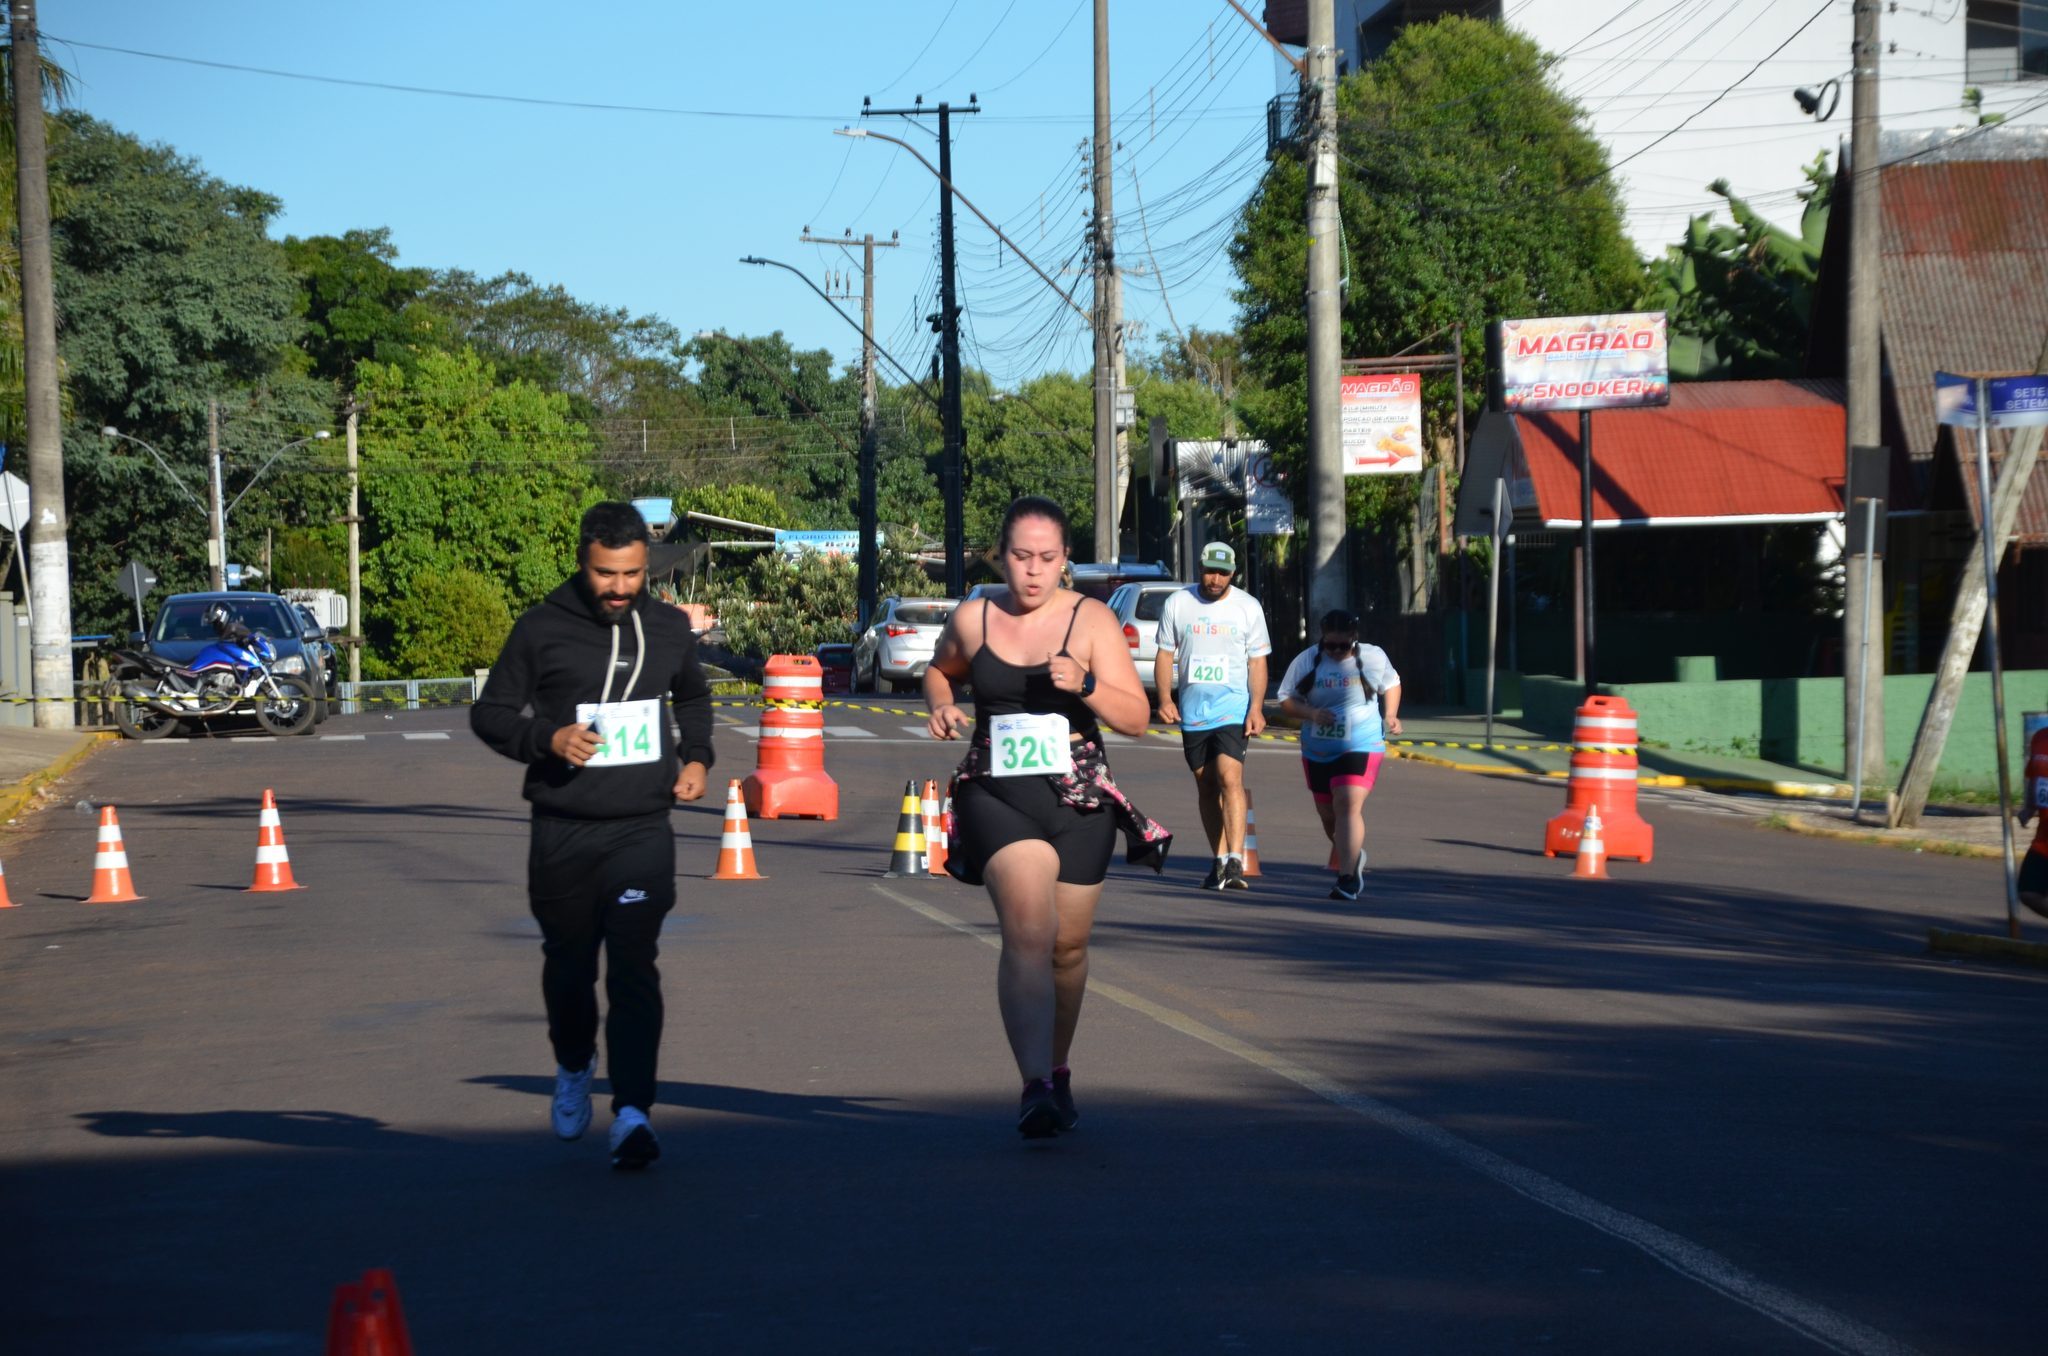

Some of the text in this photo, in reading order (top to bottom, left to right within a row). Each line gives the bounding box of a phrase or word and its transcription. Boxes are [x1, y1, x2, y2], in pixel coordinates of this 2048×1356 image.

[1517, 324, 1655, 356] MAGRÃO
[1341, 378, 1415, 394] MAGRÃO
[1533, 380, 1643, 398] SNOOKER
[2014, 387, 2046, 398] SETE
[1193, 665, 1224, 681] 420
[1316, 724, 1346, 738] 325
[1002, 735, 1058, 769] 326
